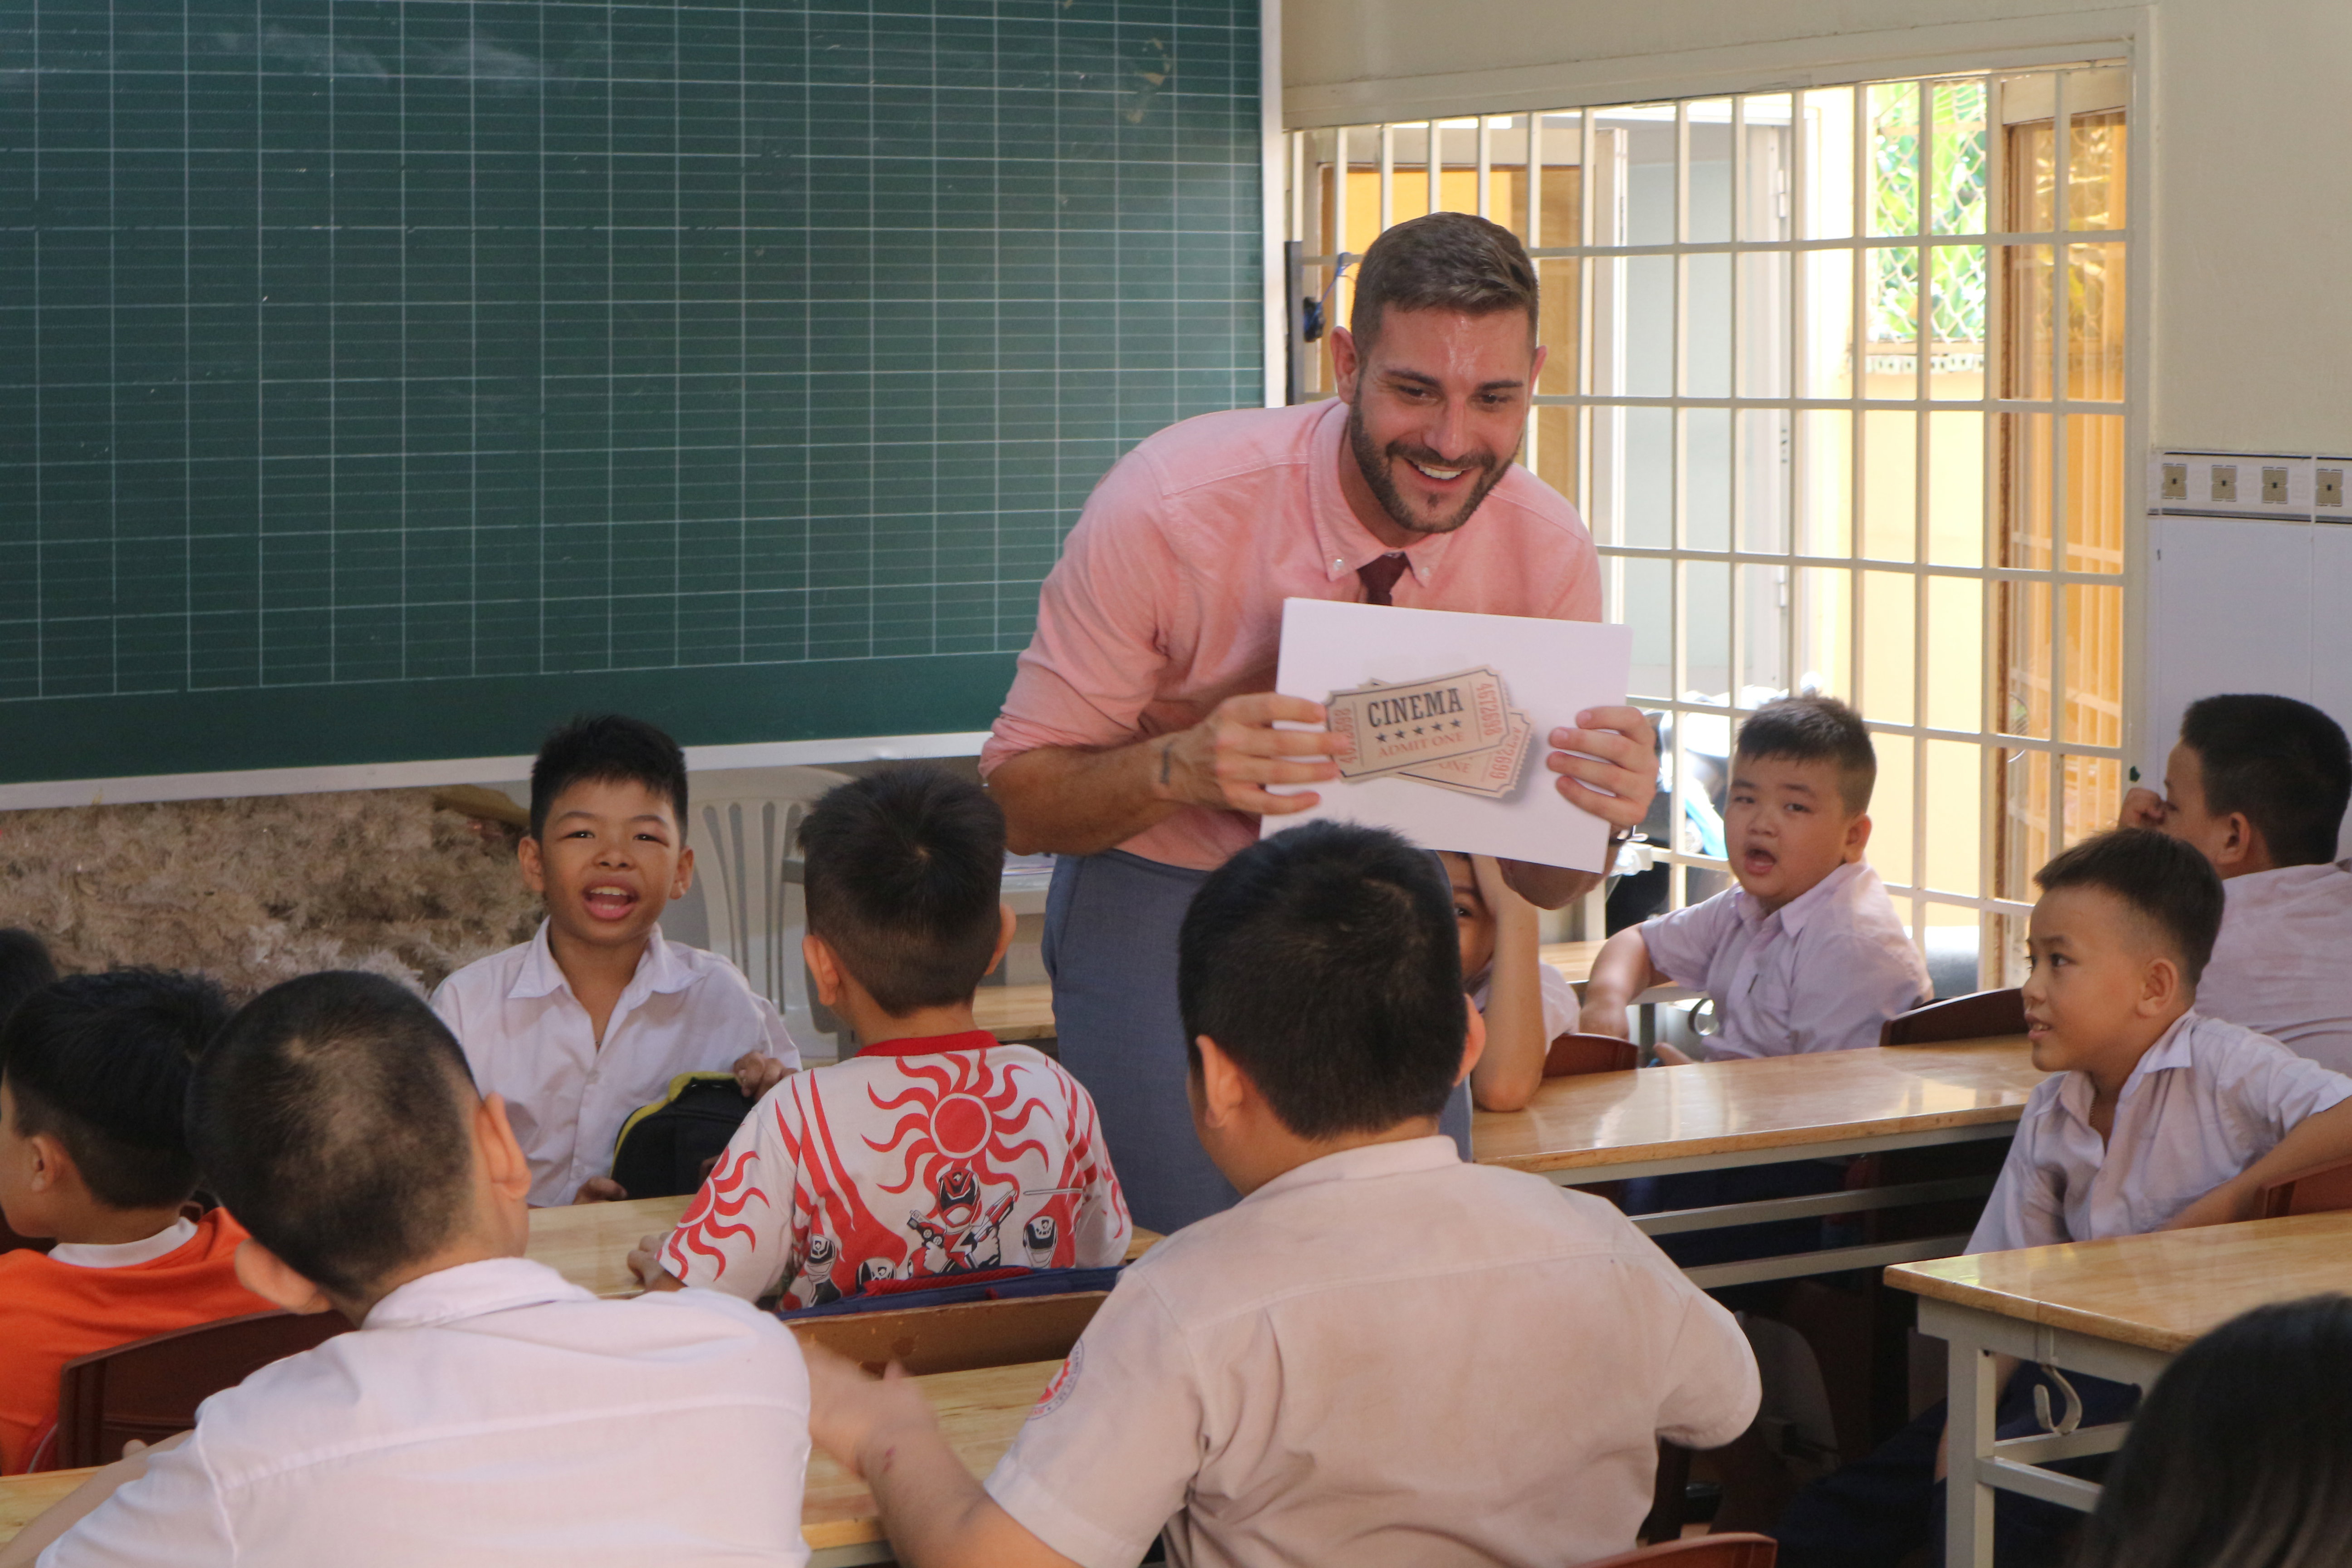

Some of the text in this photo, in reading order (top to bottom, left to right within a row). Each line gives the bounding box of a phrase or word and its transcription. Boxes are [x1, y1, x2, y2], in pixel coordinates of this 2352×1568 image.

[1367, 687, 1465, 728] CINEMA
[1378, 731, 1465, 758] ADMIT ONE
